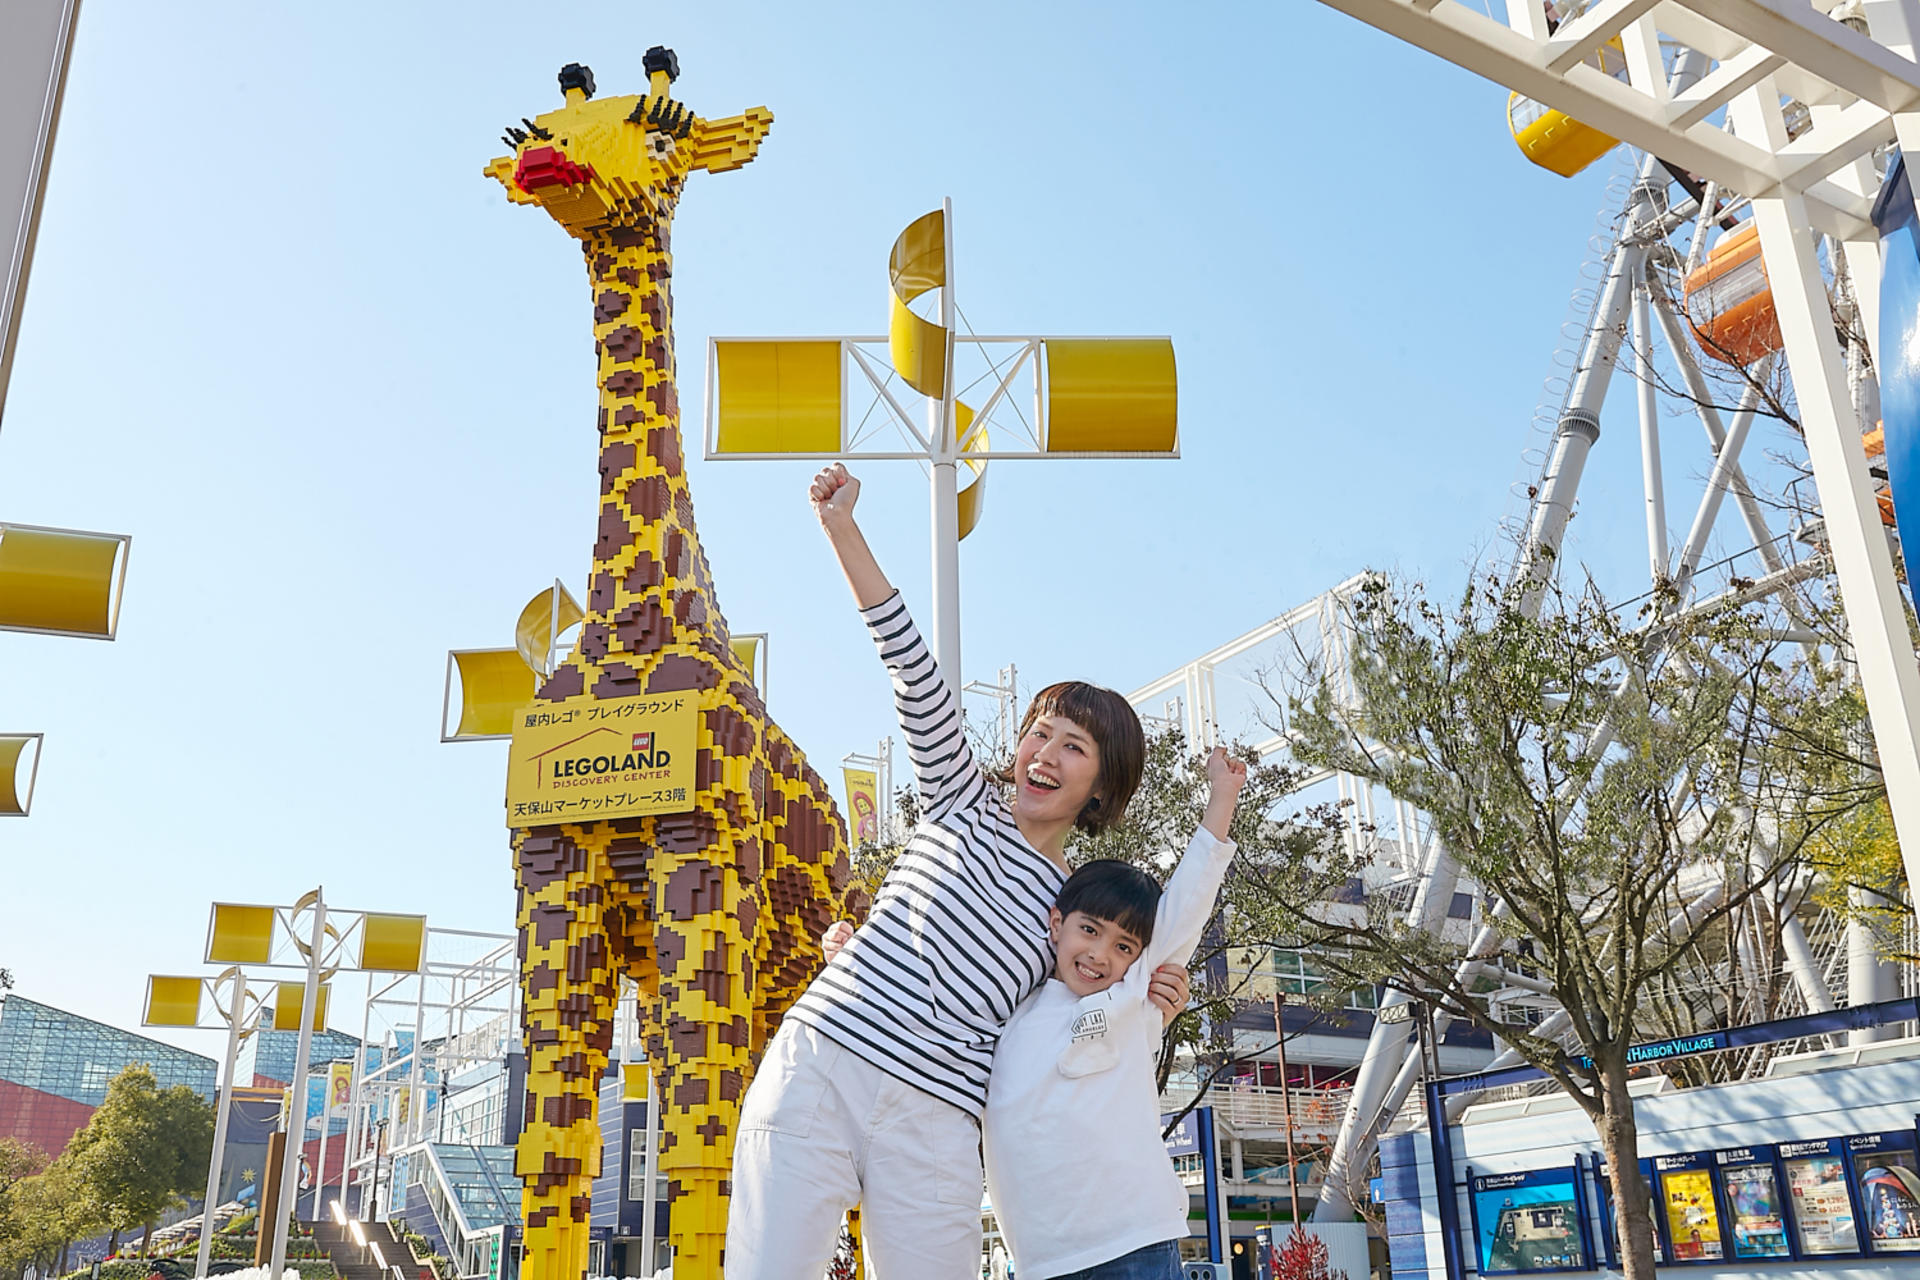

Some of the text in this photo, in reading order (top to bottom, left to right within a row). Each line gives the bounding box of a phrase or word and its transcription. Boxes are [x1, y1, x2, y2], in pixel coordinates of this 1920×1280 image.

[588, 699, 684, 721] プレイグラウンド
[554, 732, 671, 778] LEGOLAND
[553, 769, 671, 789] DISCOVERY CENTER
[514, 788, 686, 816] 天保山マーケットプレース3階
